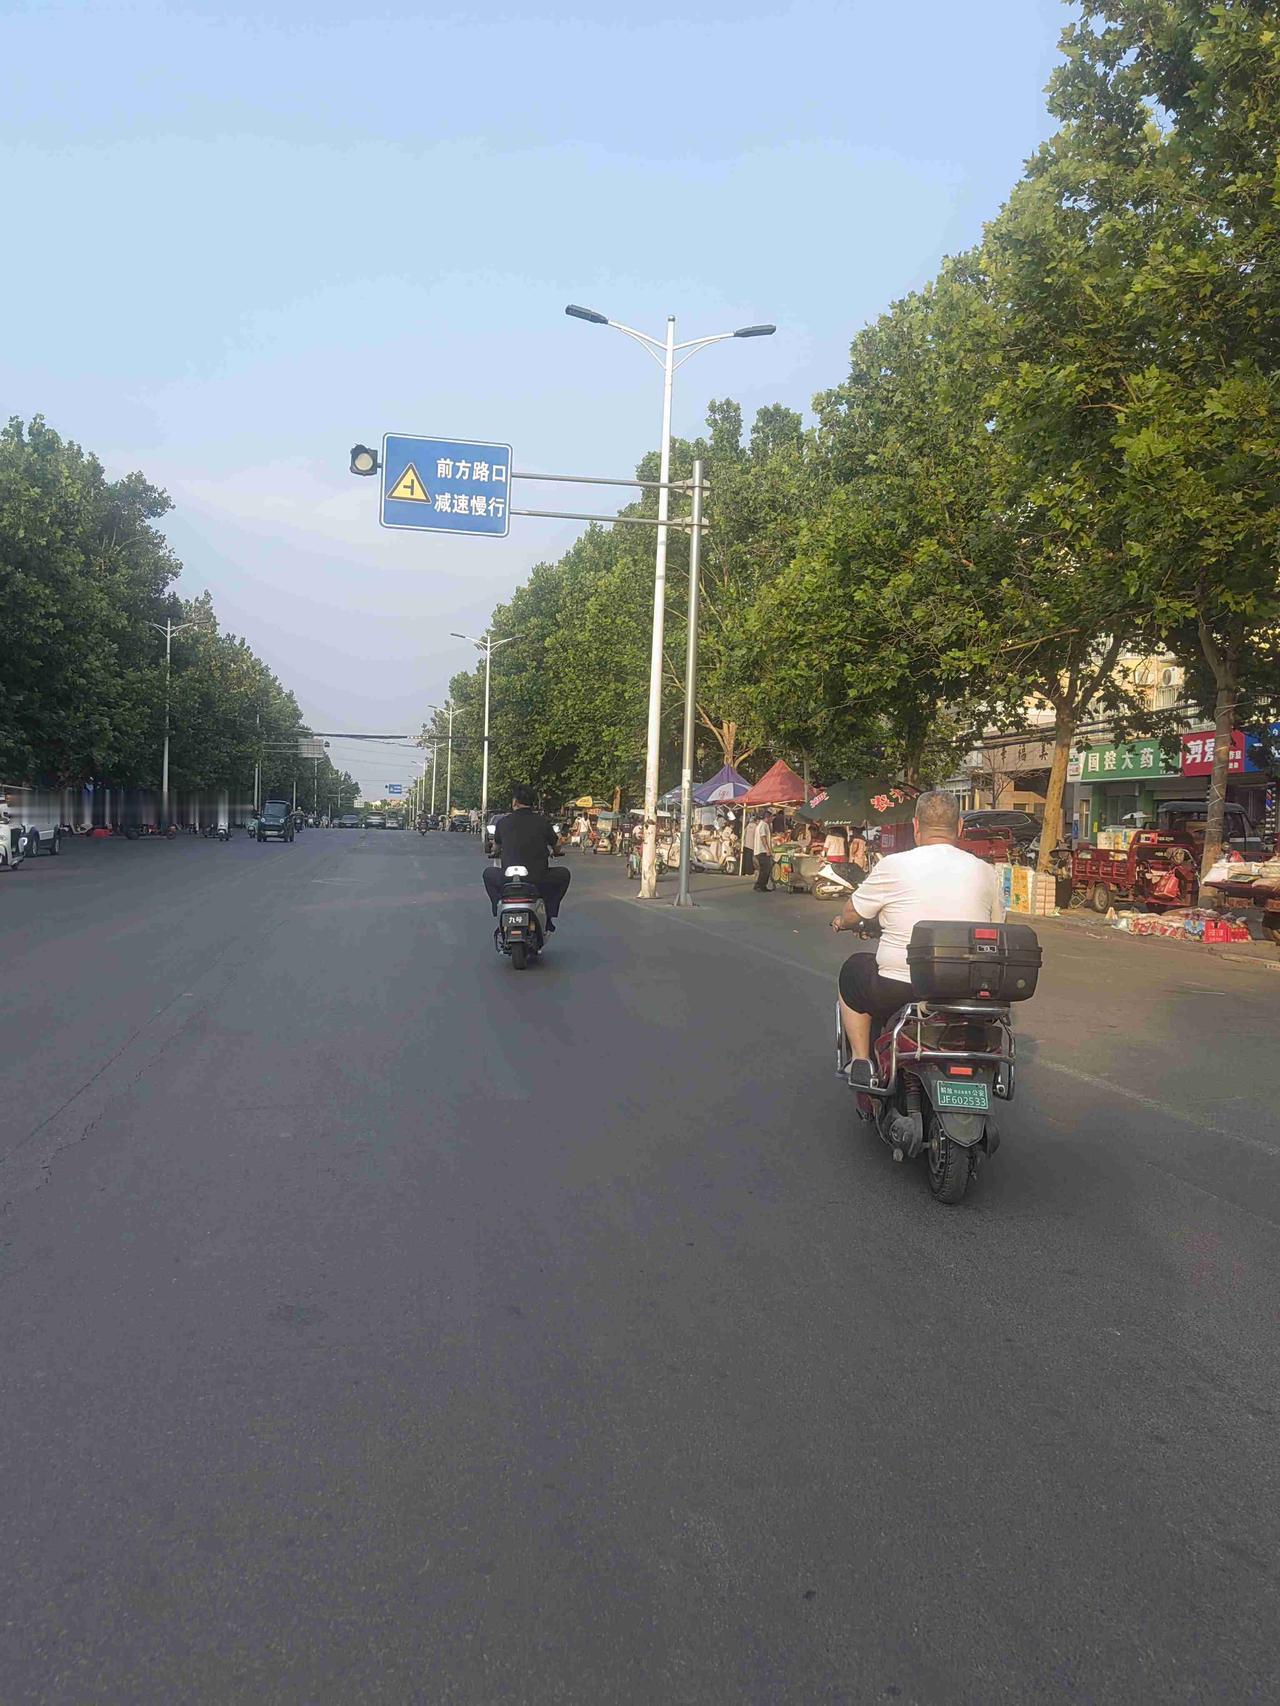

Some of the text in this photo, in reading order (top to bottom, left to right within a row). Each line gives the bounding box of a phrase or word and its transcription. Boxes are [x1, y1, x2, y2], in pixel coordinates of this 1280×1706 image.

[436, 458, 506, 482] 前方路口
[434, 493, 505, 517] 减速慢行
[941, 1095, 986, 1106] JF602533
[972, 1089, 984, 1097] 公安
